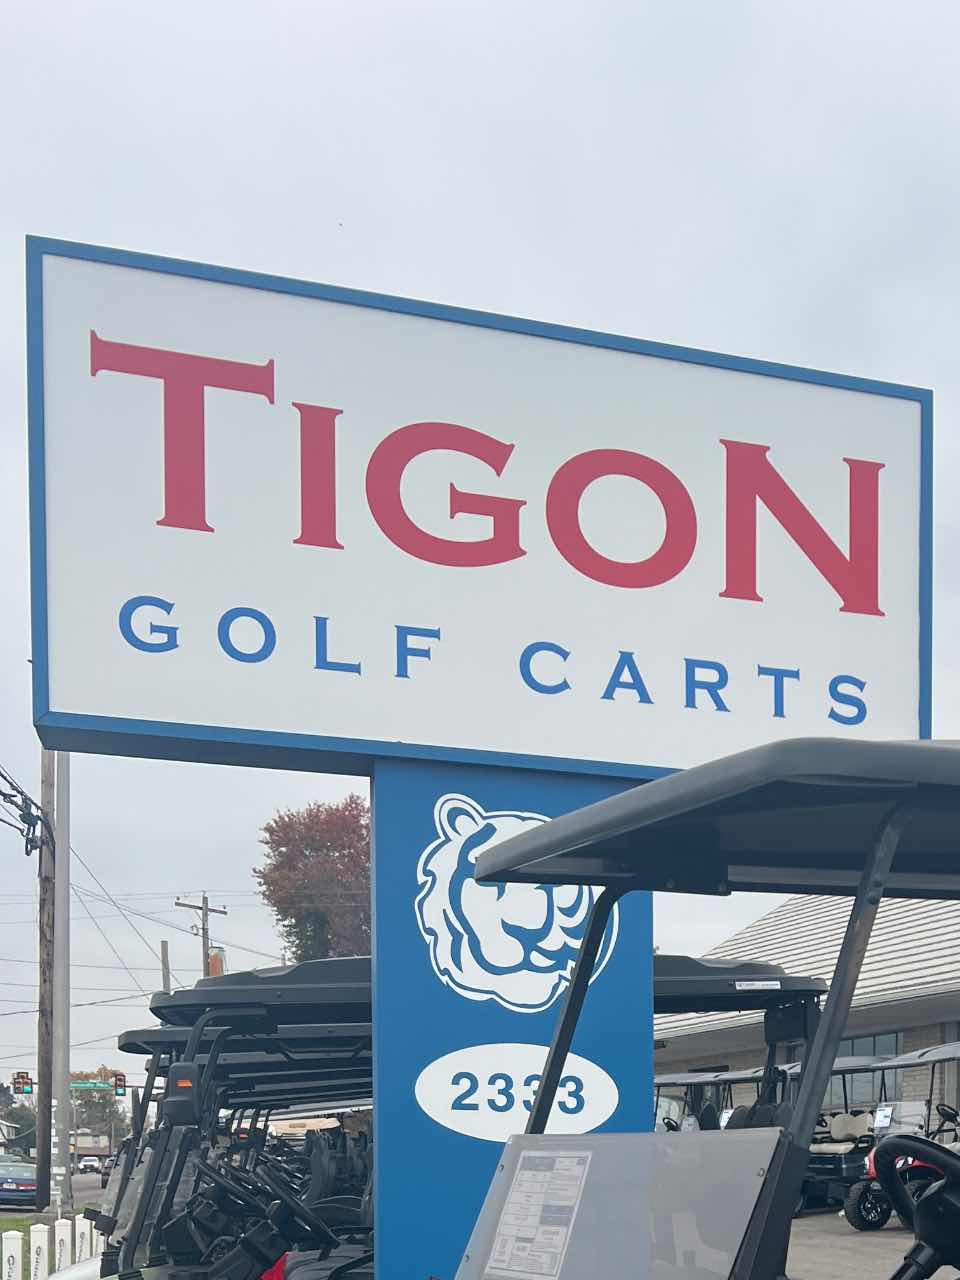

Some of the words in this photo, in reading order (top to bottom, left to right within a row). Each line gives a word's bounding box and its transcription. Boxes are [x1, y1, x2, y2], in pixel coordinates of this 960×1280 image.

[90, 329, 886, 617] TIGON
[118, 595, 441, 678] GOLF
[519, 641, 869, 726] CARTS
